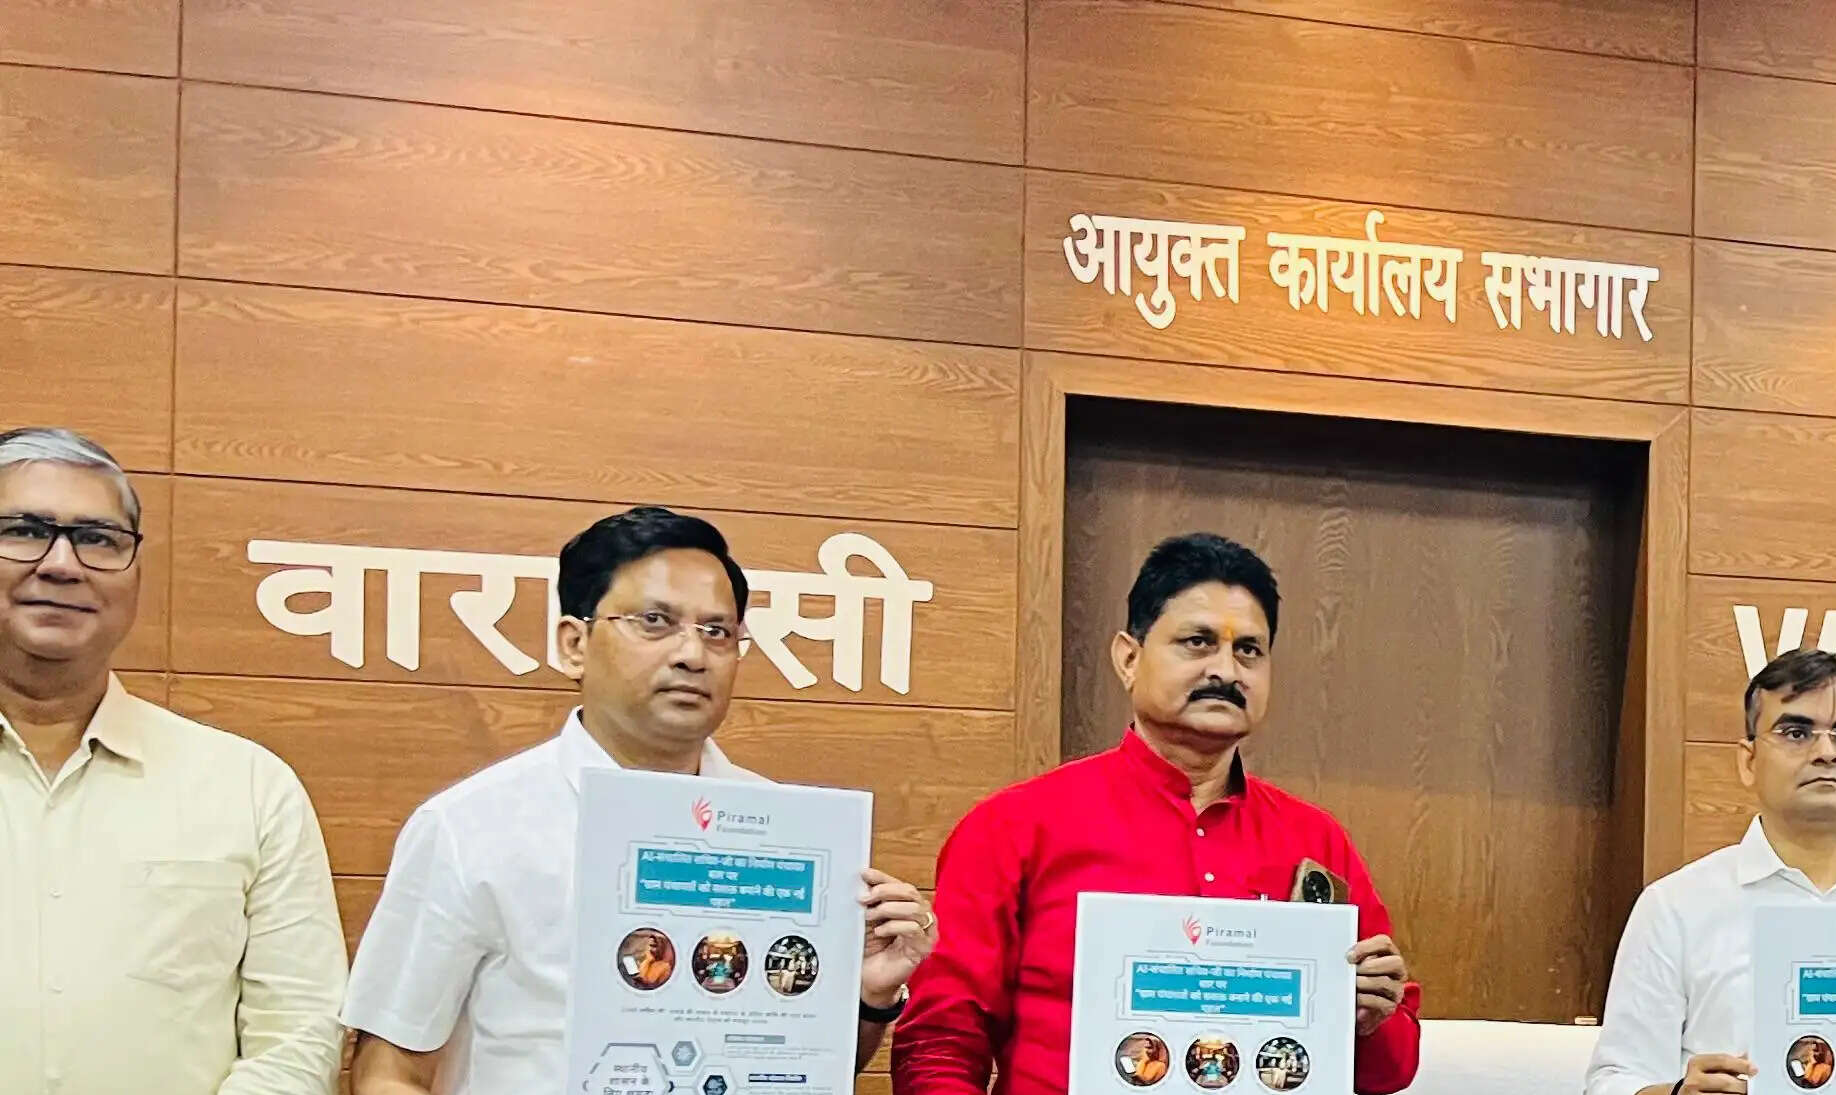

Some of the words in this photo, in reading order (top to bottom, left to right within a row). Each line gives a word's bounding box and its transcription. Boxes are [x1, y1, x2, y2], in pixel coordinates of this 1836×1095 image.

[1062, 213, 1246, 329] आयुक्त
[1267, 210, 1464, 323] कार्यालय
[1481, 251, 1660, 342] सभागार
[247, 532, 933, 695] वारासी
[717, 810, 770, 825] Piramal
[1206, 926, 1257, 938] Piramal
